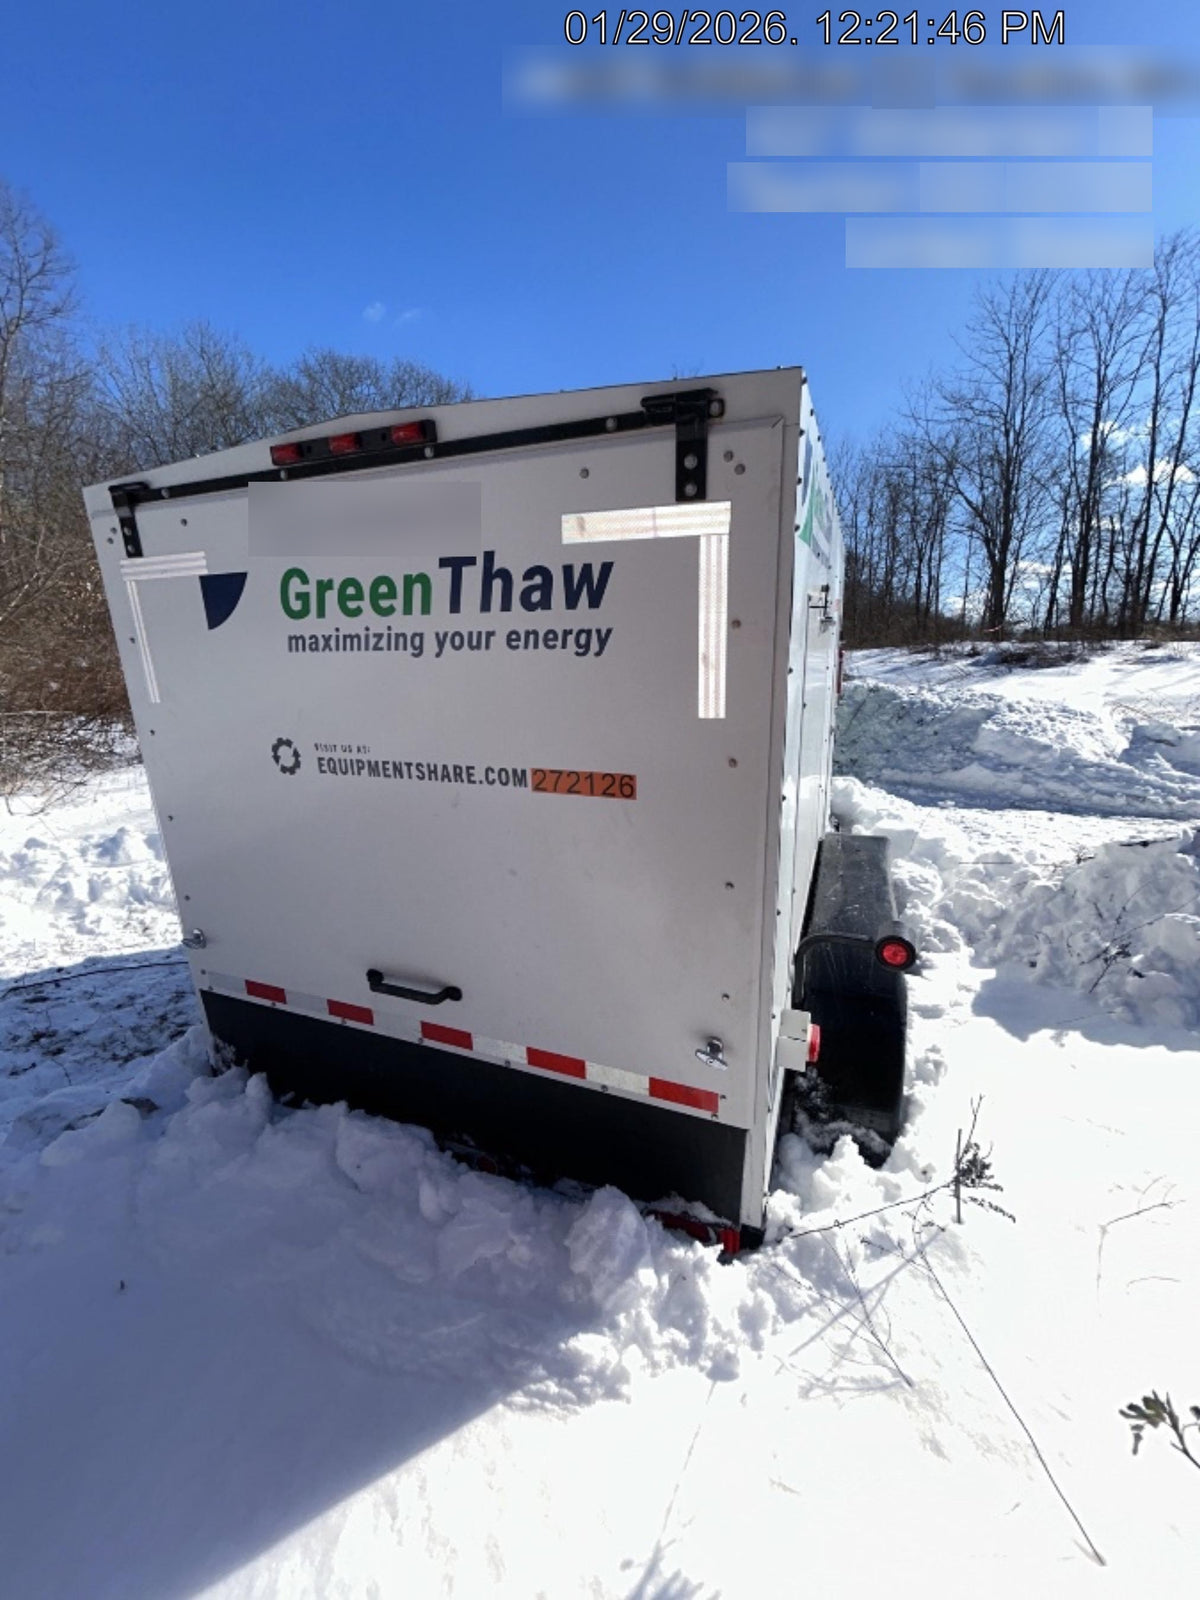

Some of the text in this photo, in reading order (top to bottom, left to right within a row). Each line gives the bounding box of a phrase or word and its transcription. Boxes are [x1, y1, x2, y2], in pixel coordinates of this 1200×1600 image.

[279, 550, 614, 621] GreenThaw
[287, 625, 614, 659] maximizing your energy
[314, 743, 337, 753] VISIT
[341, 744, 353, 754] US
[316, 756, 528, 788] EQUIPMENTSHARE.COM
[532, 768, 636, 799] 272126
